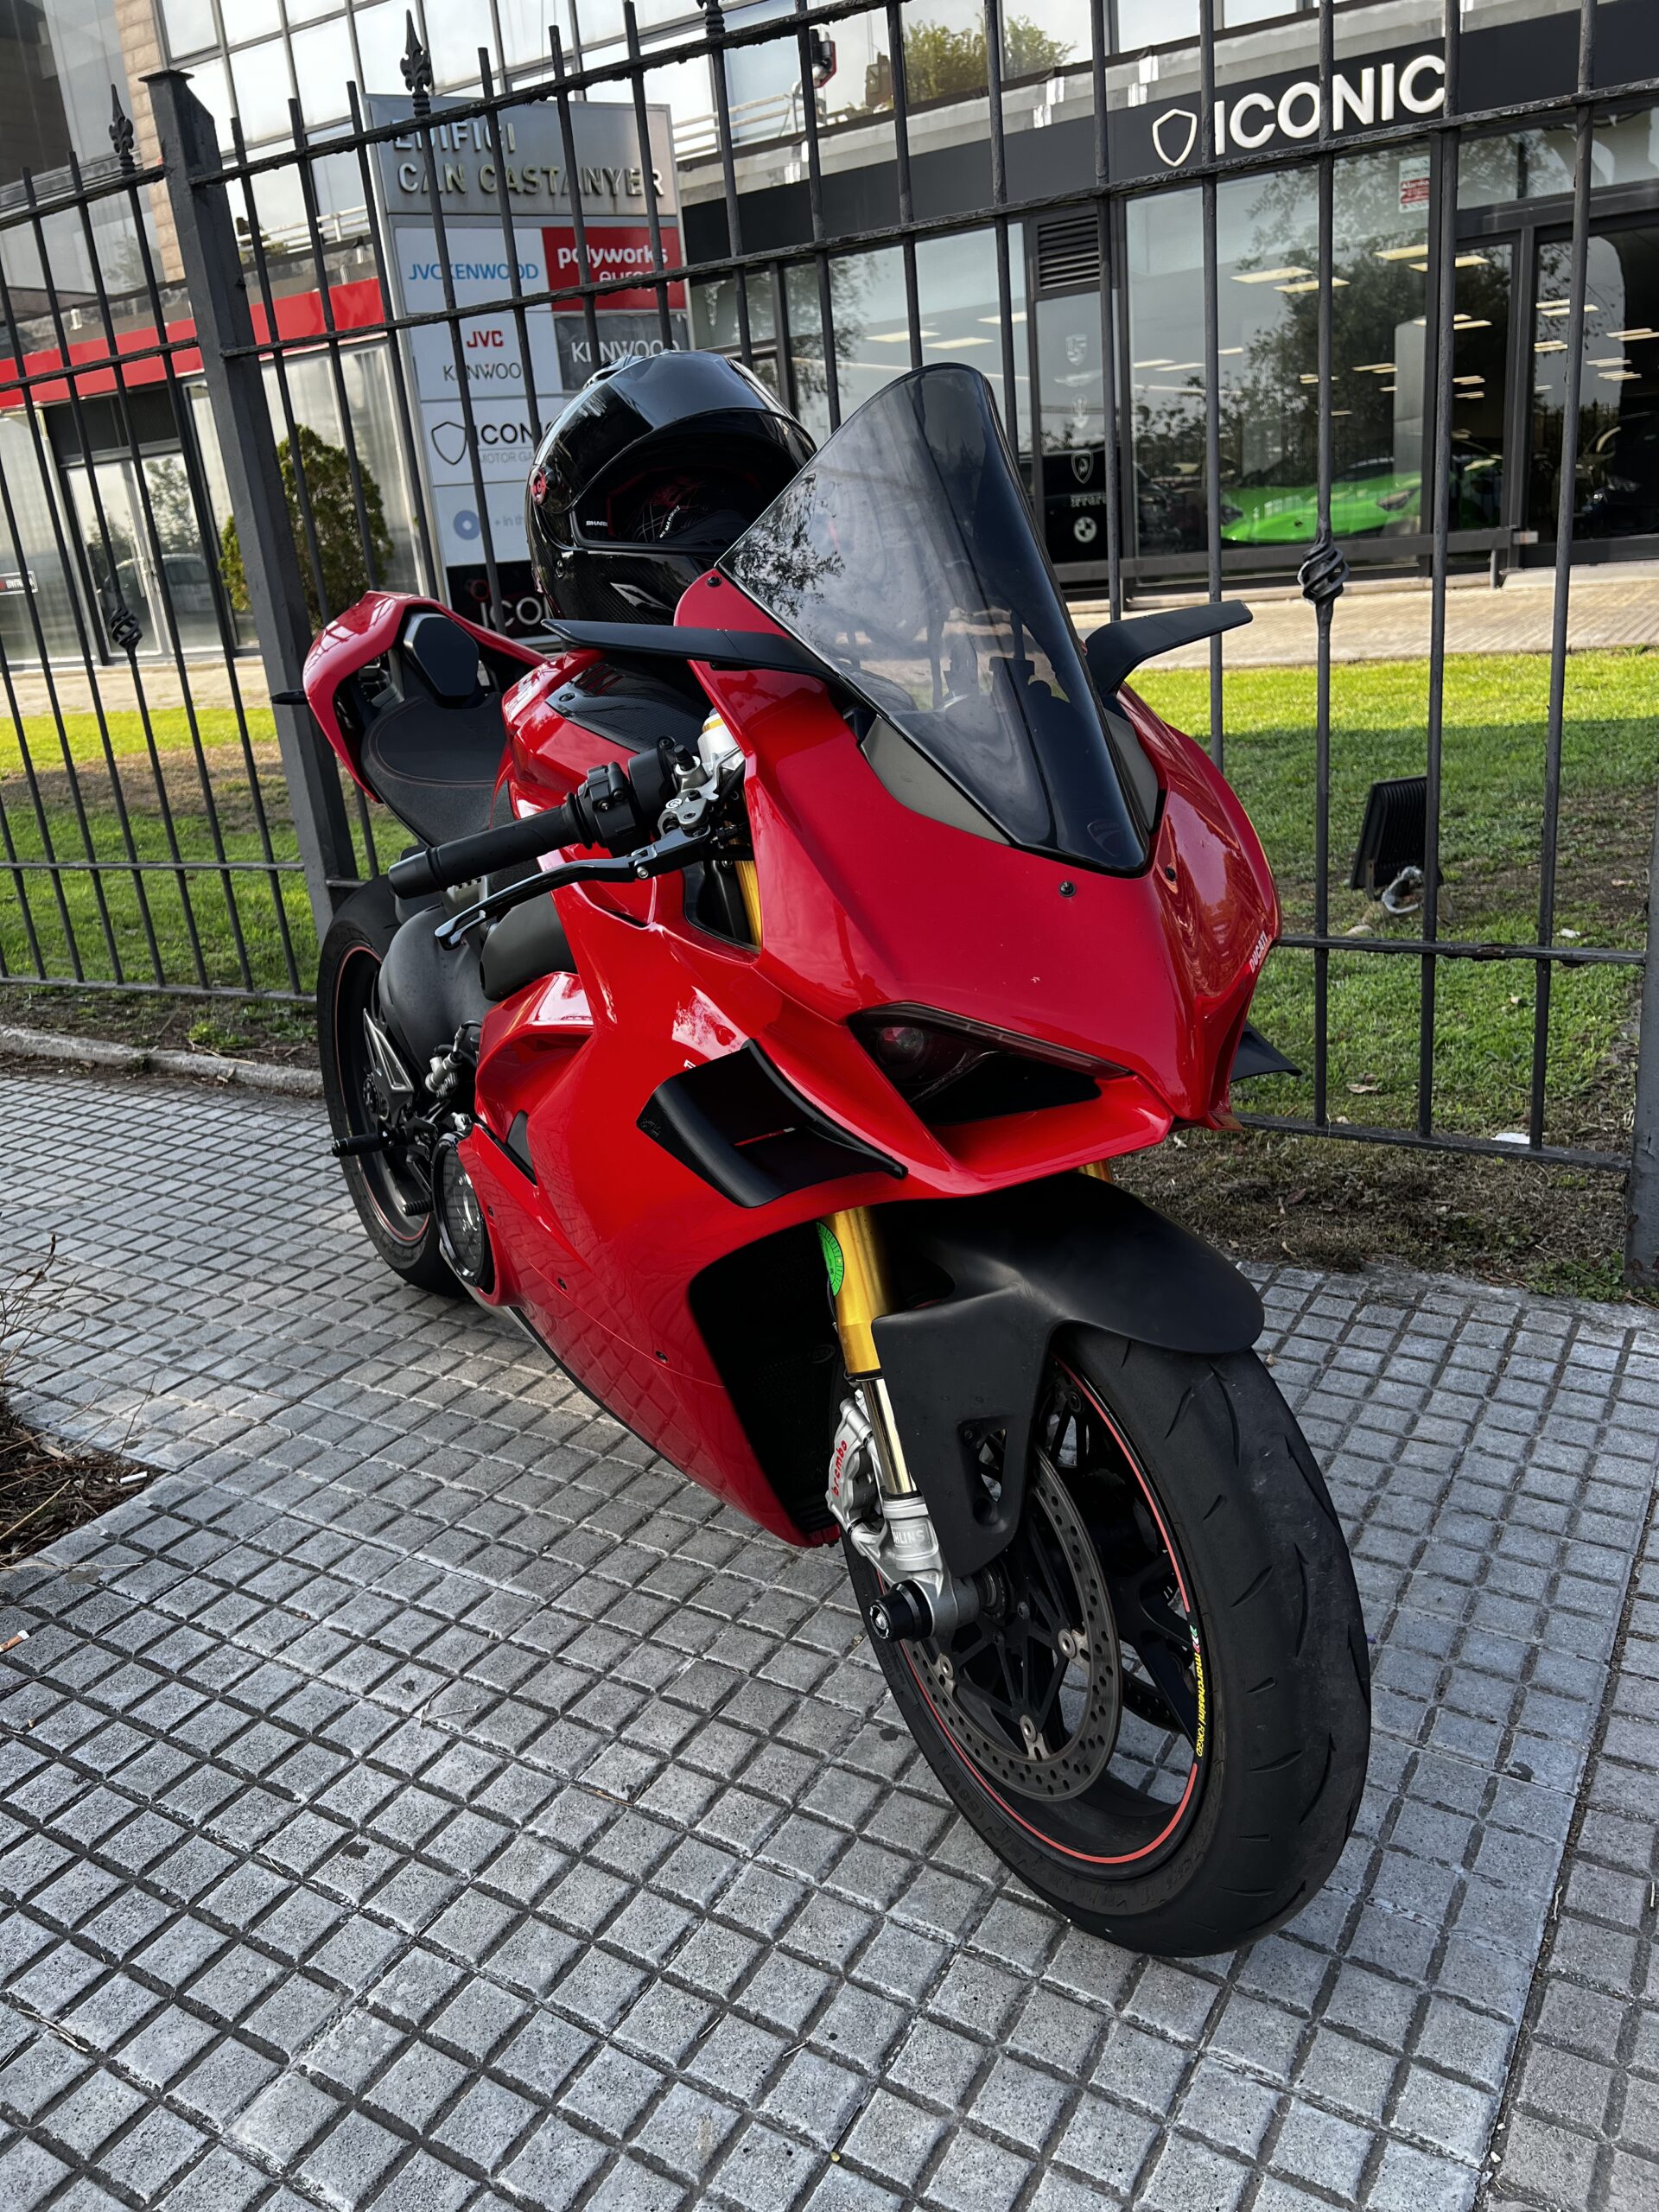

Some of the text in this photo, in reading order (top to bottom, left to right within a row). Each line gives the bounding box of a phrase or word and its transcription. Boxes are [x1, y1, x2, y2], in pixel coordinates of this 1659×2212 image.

[1215, 54, 1446, 156] ICONIC
[409, 263, 539, 281] JVCENWOD
[467, 330, 504, 348] JVC
[571, 340, 681, 364] KNWOO
[1249, 930, 1268, 974] DUCATI
[831, 1440, 848, 1497] brembo
[1194, 1651, 1206, 1726] marchesini
